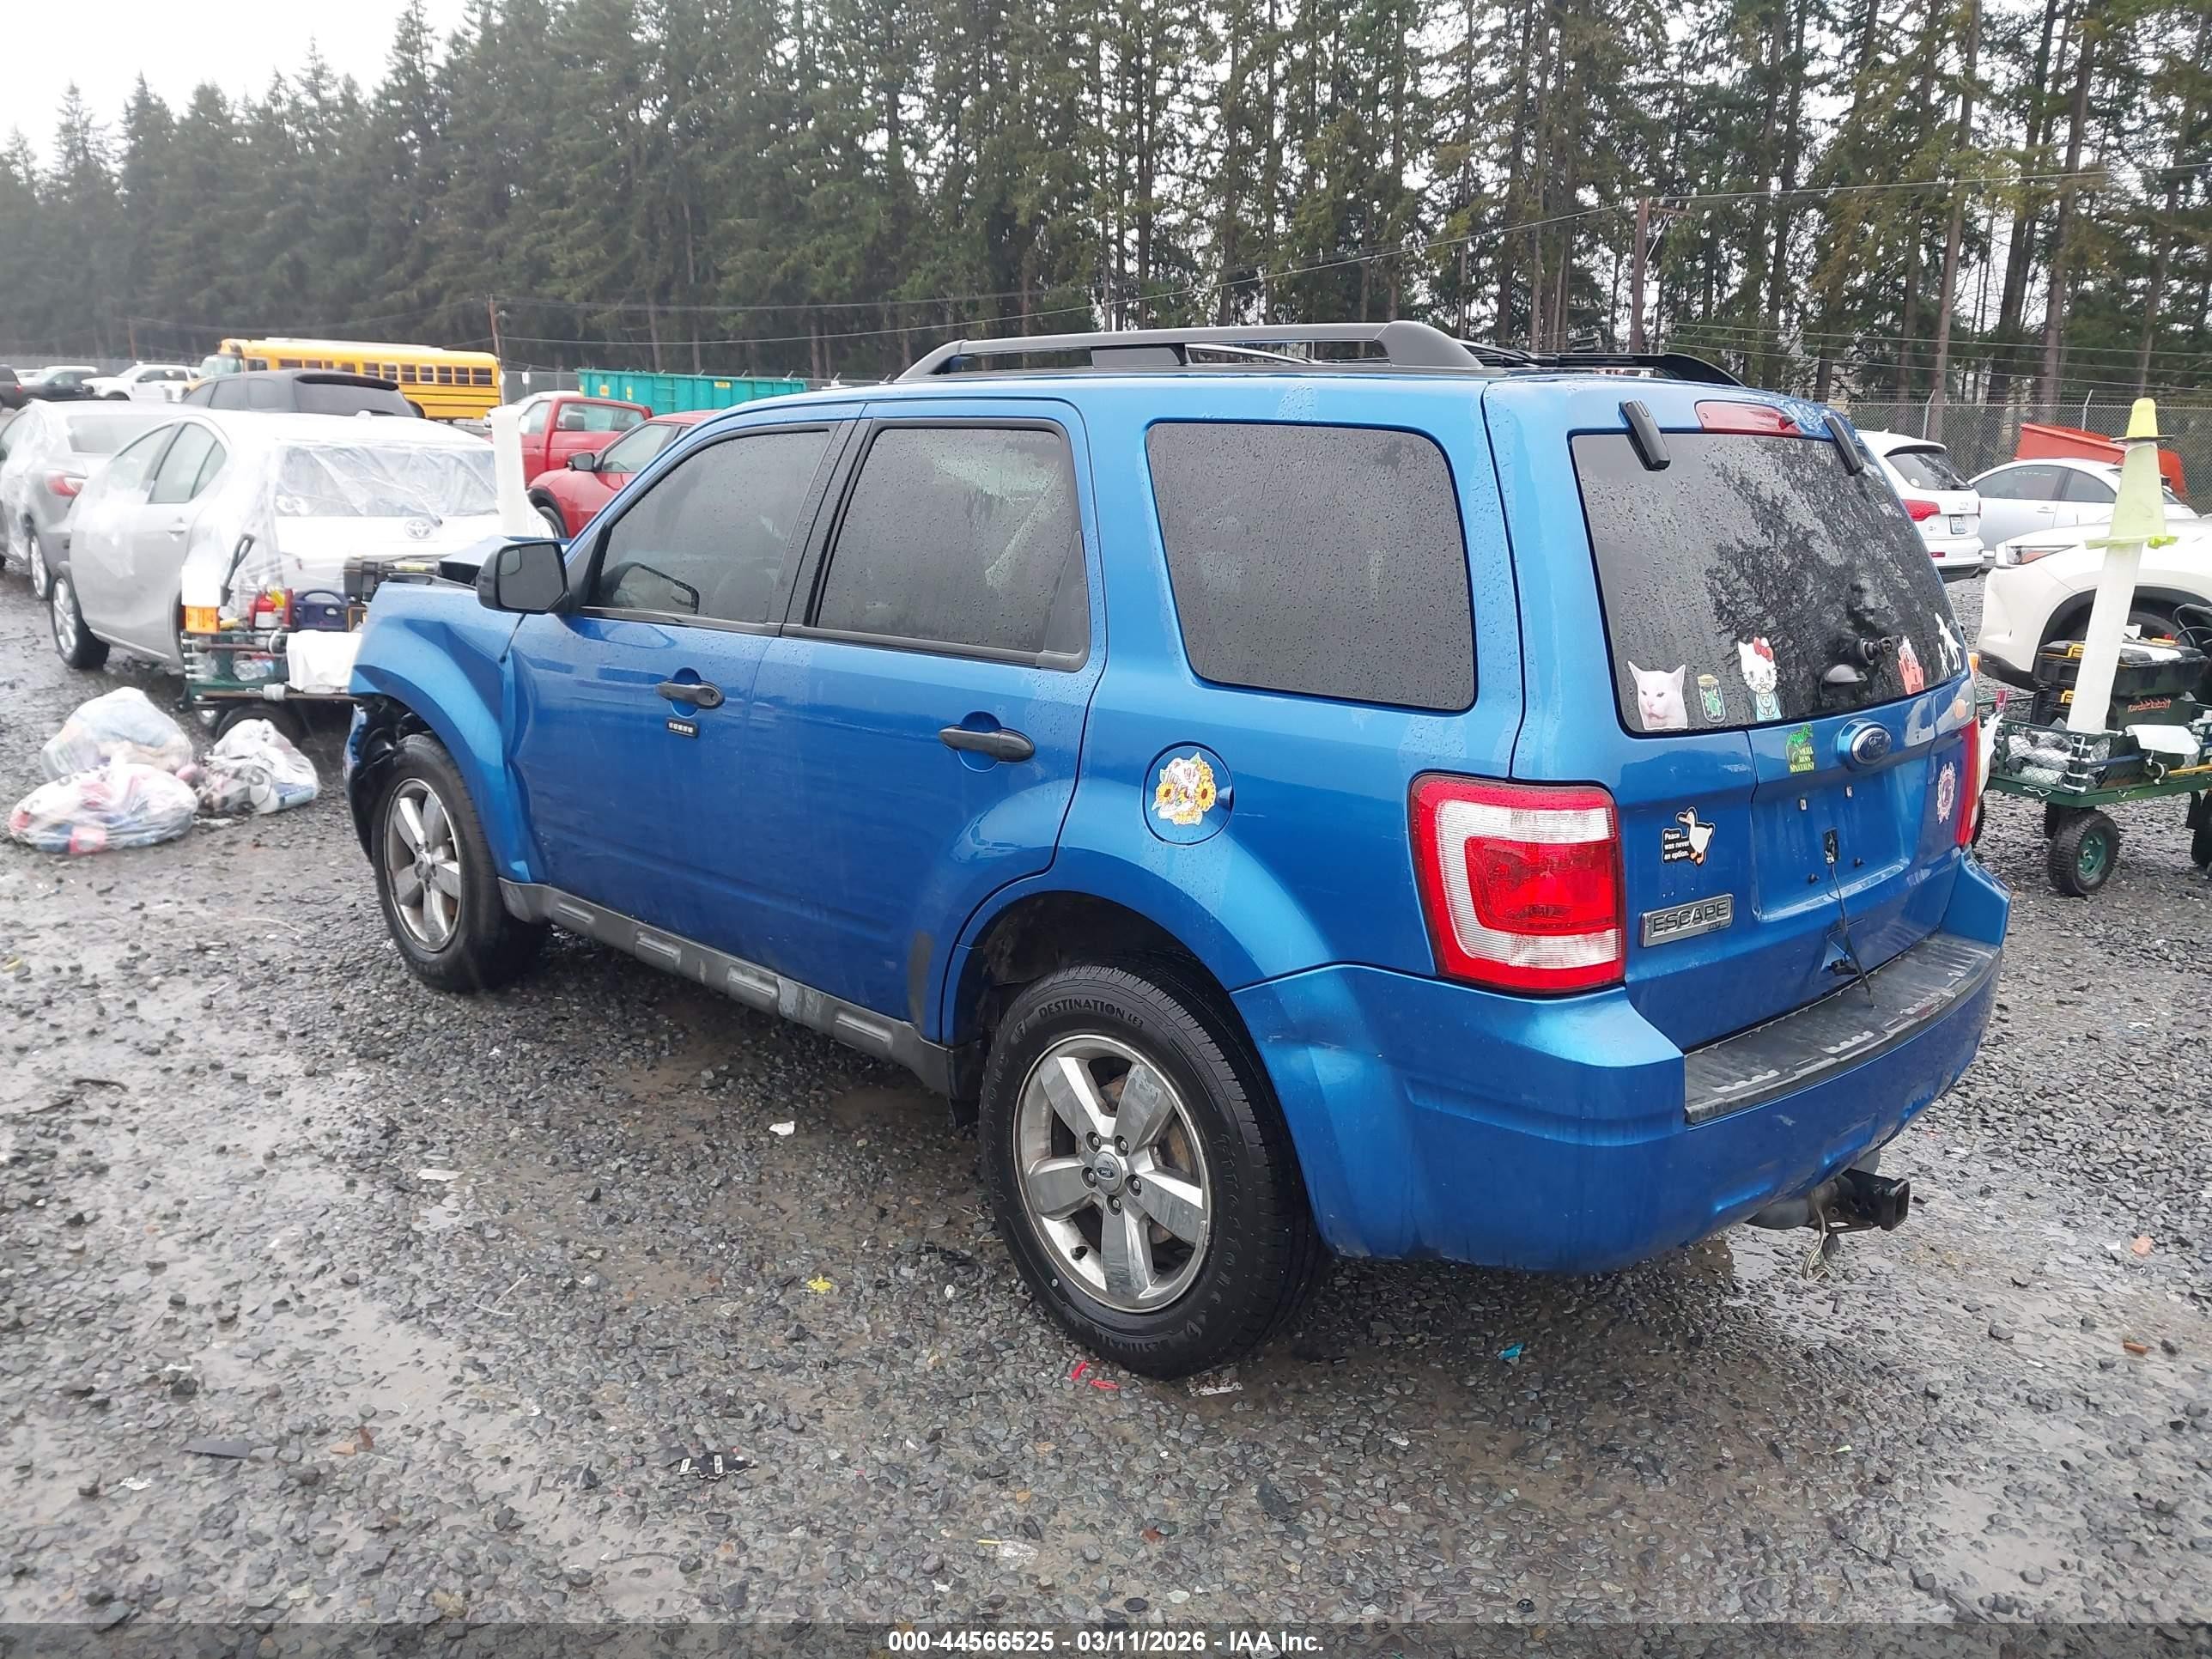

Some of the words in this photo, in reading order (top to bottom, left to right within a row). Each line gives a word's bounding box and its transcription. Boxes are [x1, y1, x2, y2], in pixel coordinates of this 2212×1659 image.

[1664, 832, 1680, 841] Peace
[1652, 901, 1729, 933] ESCAPE
[1037, 997, 1125, 1020] DESTINATION
